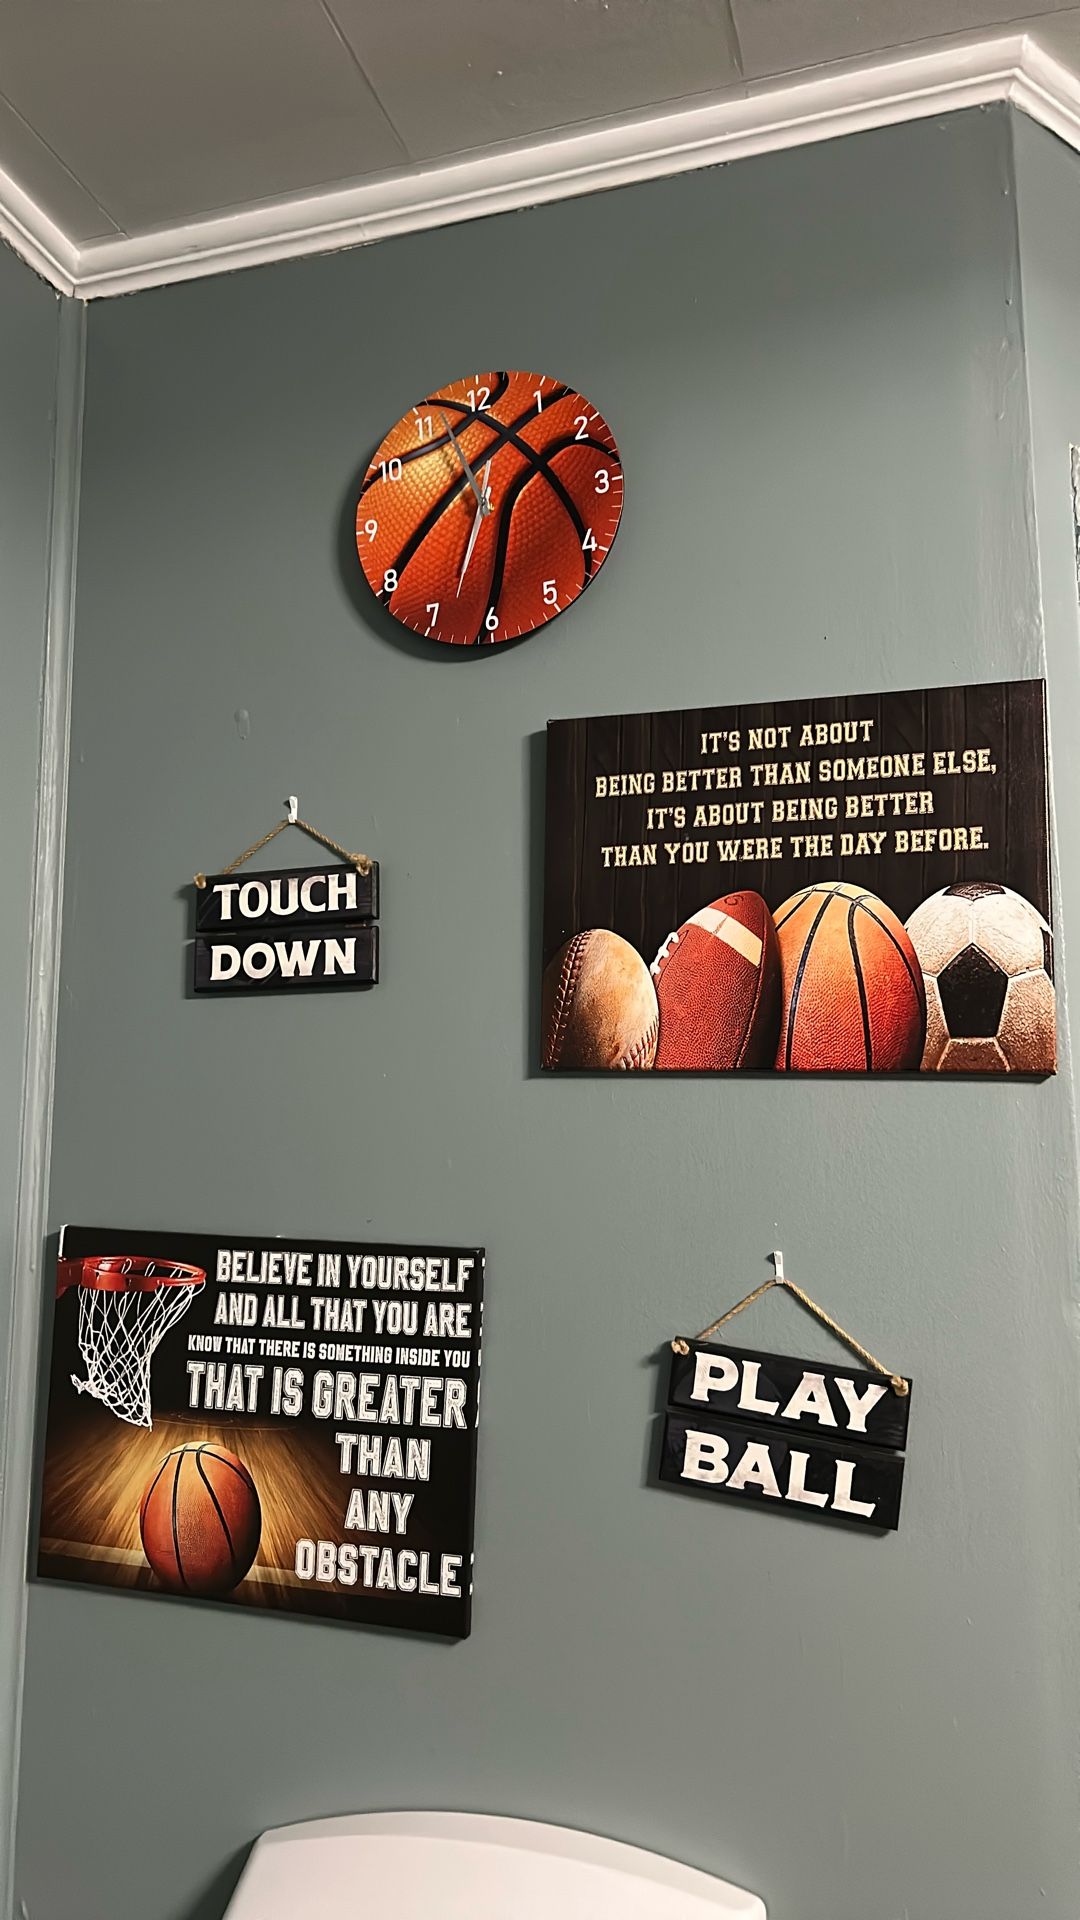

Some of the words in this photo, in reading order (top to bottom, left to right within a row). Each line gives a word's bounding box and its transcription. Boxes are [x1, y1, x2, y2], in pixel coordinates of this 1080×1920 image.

[466, 387, 491, 412] 12
[533, 390, 543, 413] 1
[415, 415, 433, 440] 11
[573, 415, 589, 440] 2
[378, 458, 402, 483] 10
[594, 469, 610, 494] 3
[364, 519, 378, 543] 9
[581, 528, 598, 551] 4
[383, 568, 398, 593] 8
[542, 579, 558, 604] 5
[426, 602, 440, 627] 7
[485, 606, 499, 631] 6
[700, 730, 741, 755] IT'S
[748, 726, 792, 750] NOT
[799, 719, 874, 747] ABOUT
[595, 772, 656, 798] BEING
[662, 766, 742, 793] BETTER
[750, 761, 811, 787] THAN
[818, 752, 926, 783] SOMEONE
[932, 748, 997, 776] ELSE,
[646, 806, 686, 830] IT'S
[693, 801, 764, 828] ABOUT
[772, 797, 838, 823] BEING
[845, 790, 934, 819] BETTER
[601, 843, 657, 868] THAN
[664, 840, 709, 865] YOU
[716, 837, 783, 862] WERE
[790, 834, 834, 858] THE
[840, 831, 887, 857] DAY
[894, 826, 989, 854] BEFORE.
[212, 872, 358, 921] TOUCH
[210, 937, 357, 981] DOWN
[216, 1249, 313, 1287] BELIEVE
[316, 1253, 342, 1288] IN
[346, 1254, 475, 1293] YOURSELF
[213, 1291, 258, 1326] AND
[261, 1294, 306, 1330] ALL
[310, 1296, 368, 1333] THAT
[372, 1299, 419, 1336] YOU
[422, 1301, 472, 1338] ARE
[187, 1334, 223, 1353] KNOW
[225, 1336, 256, 1355] THAT
[258, 1338, 301, 1358] THERE
[302, 1341, 316, 1360] IS
[318, 1343, 393, 1364] SOMETHING
[395, 1347, 440, 1367] INSIDE
[443, 1349, 471, 1369] YOU
[186, 1360, 265, 1413] THAT
[270, 1366, 305, 1417] IS
[311, 1369, 468, 1430] GREATER
[690, 1351, 889, 1433] PLAY
[334, 1432, 431, 1481] THAN
[680, 1429, 876, 1518] BALL
[343, 1488, 415, 1535] ANY
[294, 1538, 464, 1598] OBSTACLE
